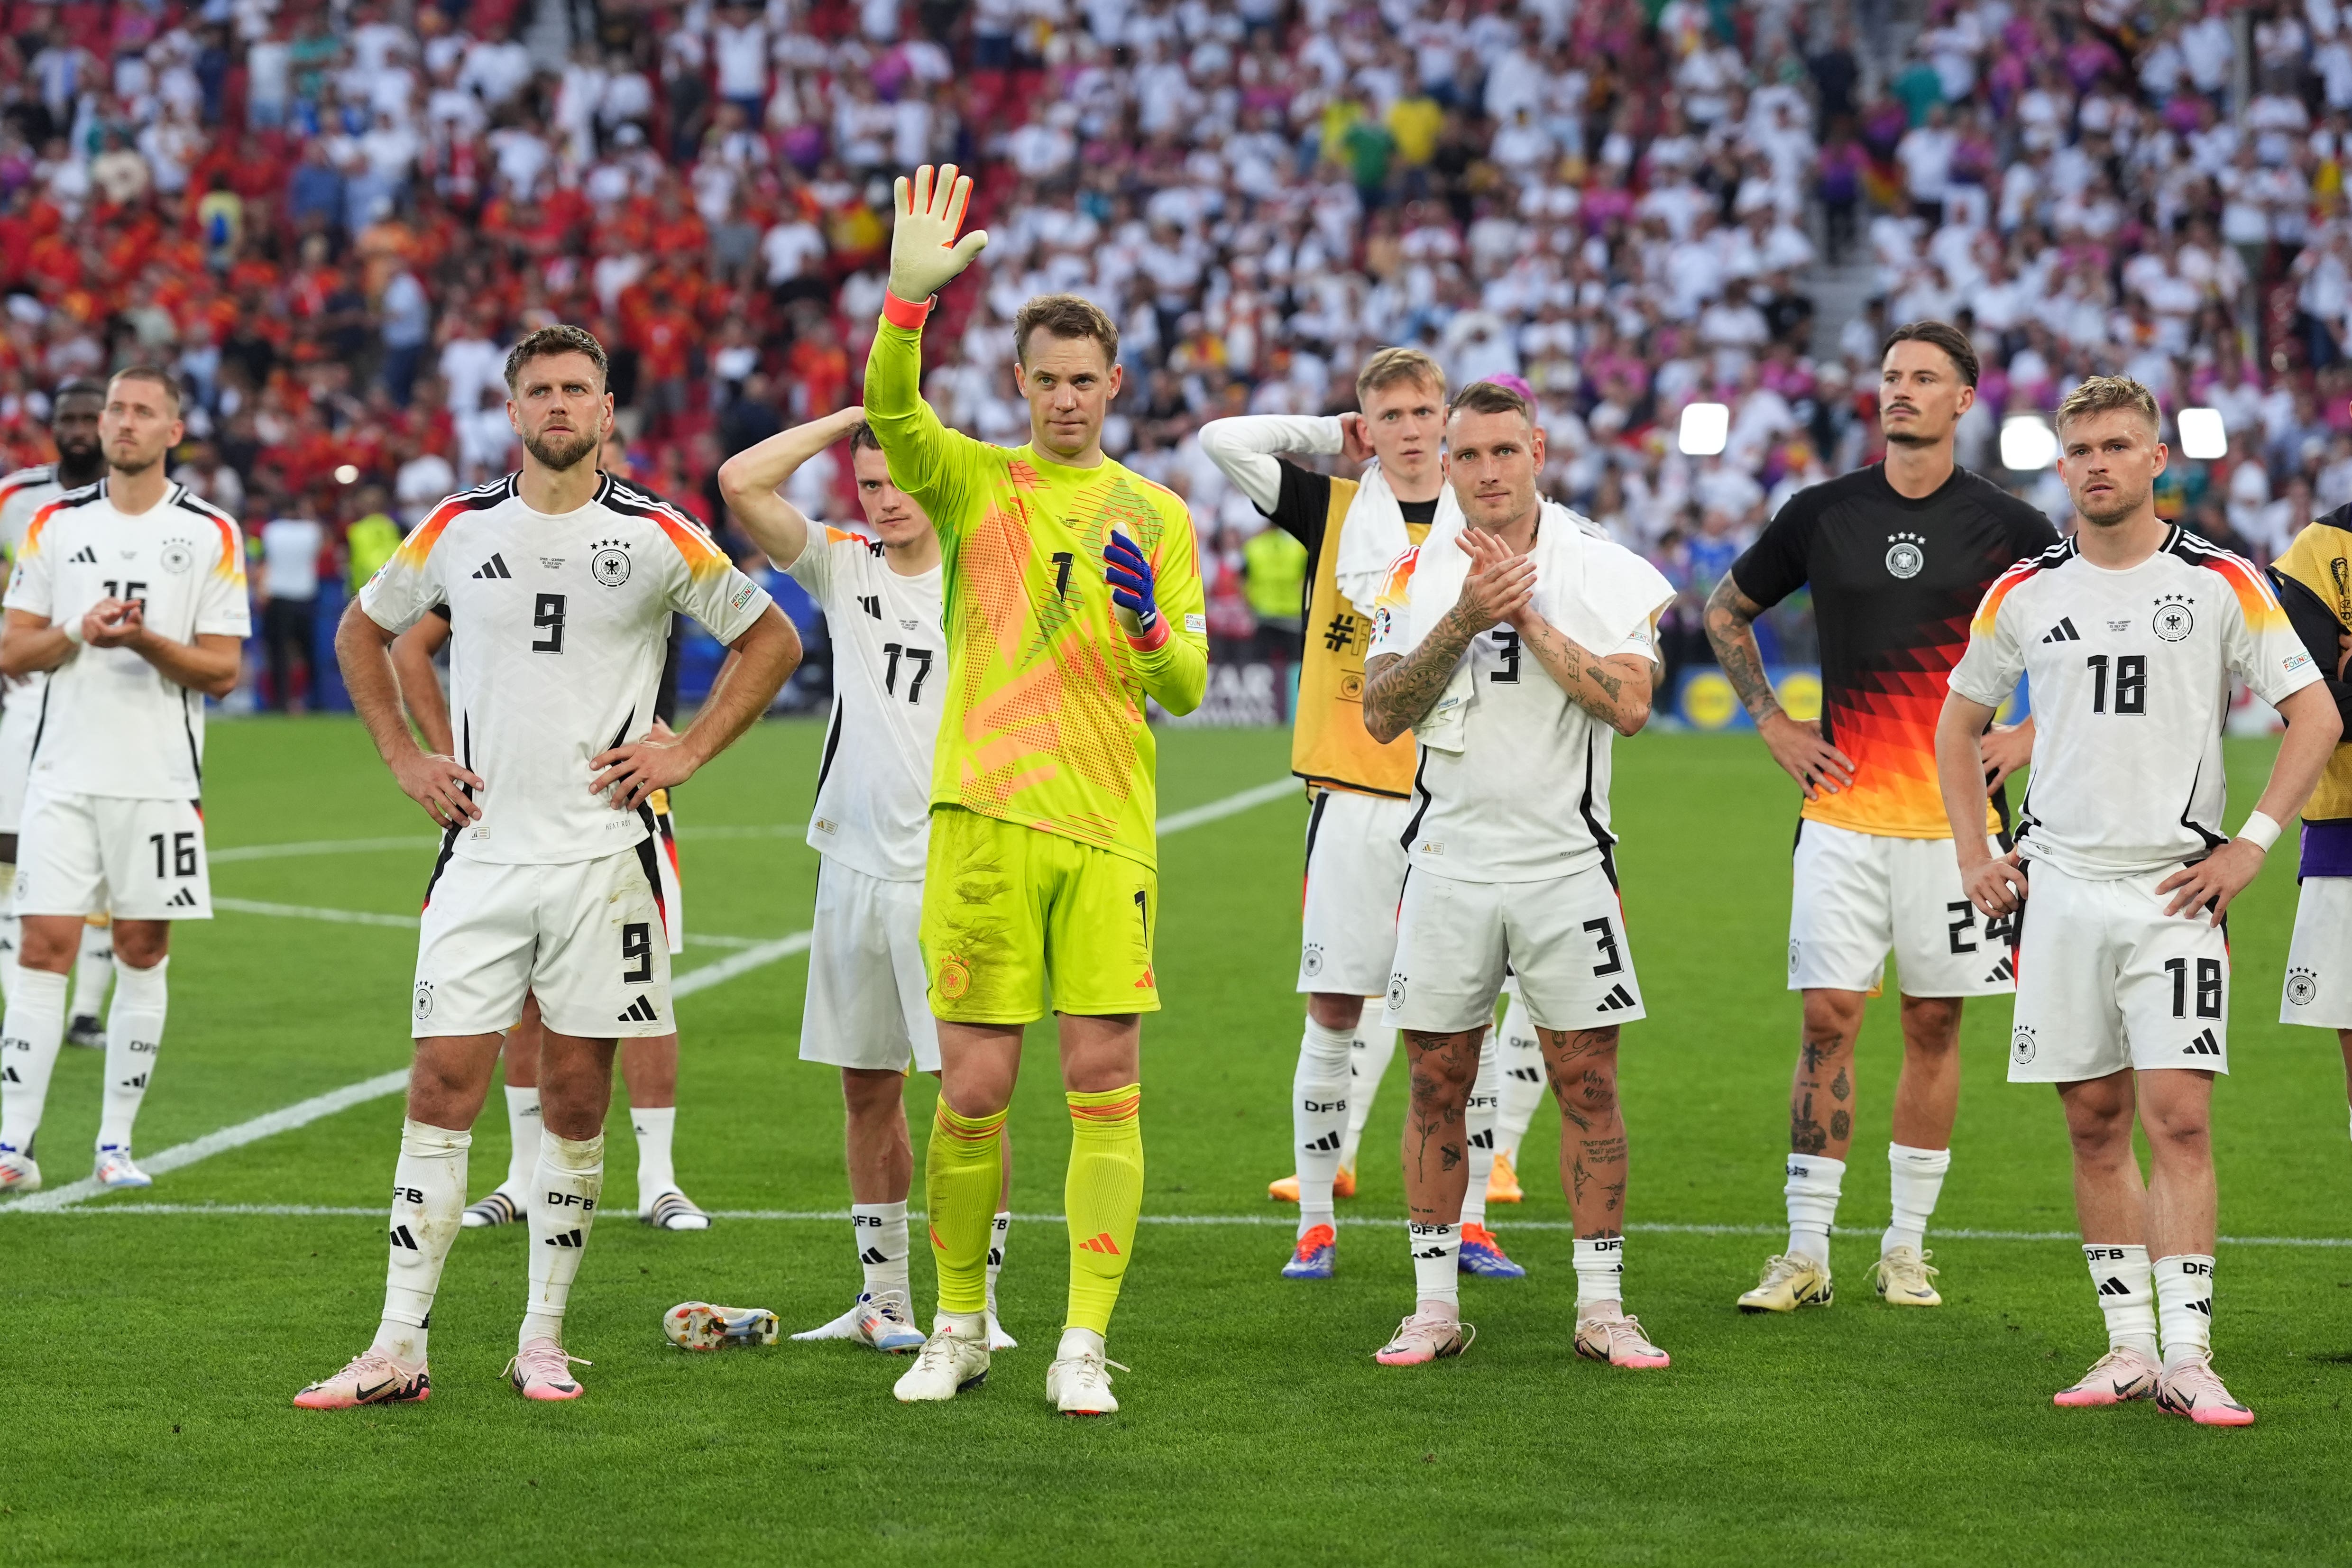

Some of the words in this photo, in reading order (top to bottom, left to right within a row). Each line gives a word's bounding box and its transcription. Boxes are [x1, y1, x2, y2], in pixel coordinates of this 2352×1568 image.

[731, 593, 740, 604] UEFA
[1052, 552, 1075, 604] 1
[533, 593, 567, 654] 9
[883, 643, 933, 705] 17
[1491, 631, 1520, 684] 3
[2282, 656, 2292, 664] UEFA
[2087, 655, 2147, 716] 18
[149, 831, 197, 879] 16
[1135, 890, 1148, 949] 1
[1947, 901, 2013, 955] 24
[623, 923, 654, 985] 9
[1583, 916, 1624, 978] 3
[2165, 958, 2222, 1021] 18
[0, 1037, 29, 1051] FB
[1583, 1070, 1604, 1087] Why
[1305, 1100, 1346, 1113] DFB
[394, 1187, 423, 1203] FB
[548, 1192, 593, 1210] DFB
[1411, 1223, 1450, 1235] DFB
[2086, 1249, 2125, 1260] DFB
